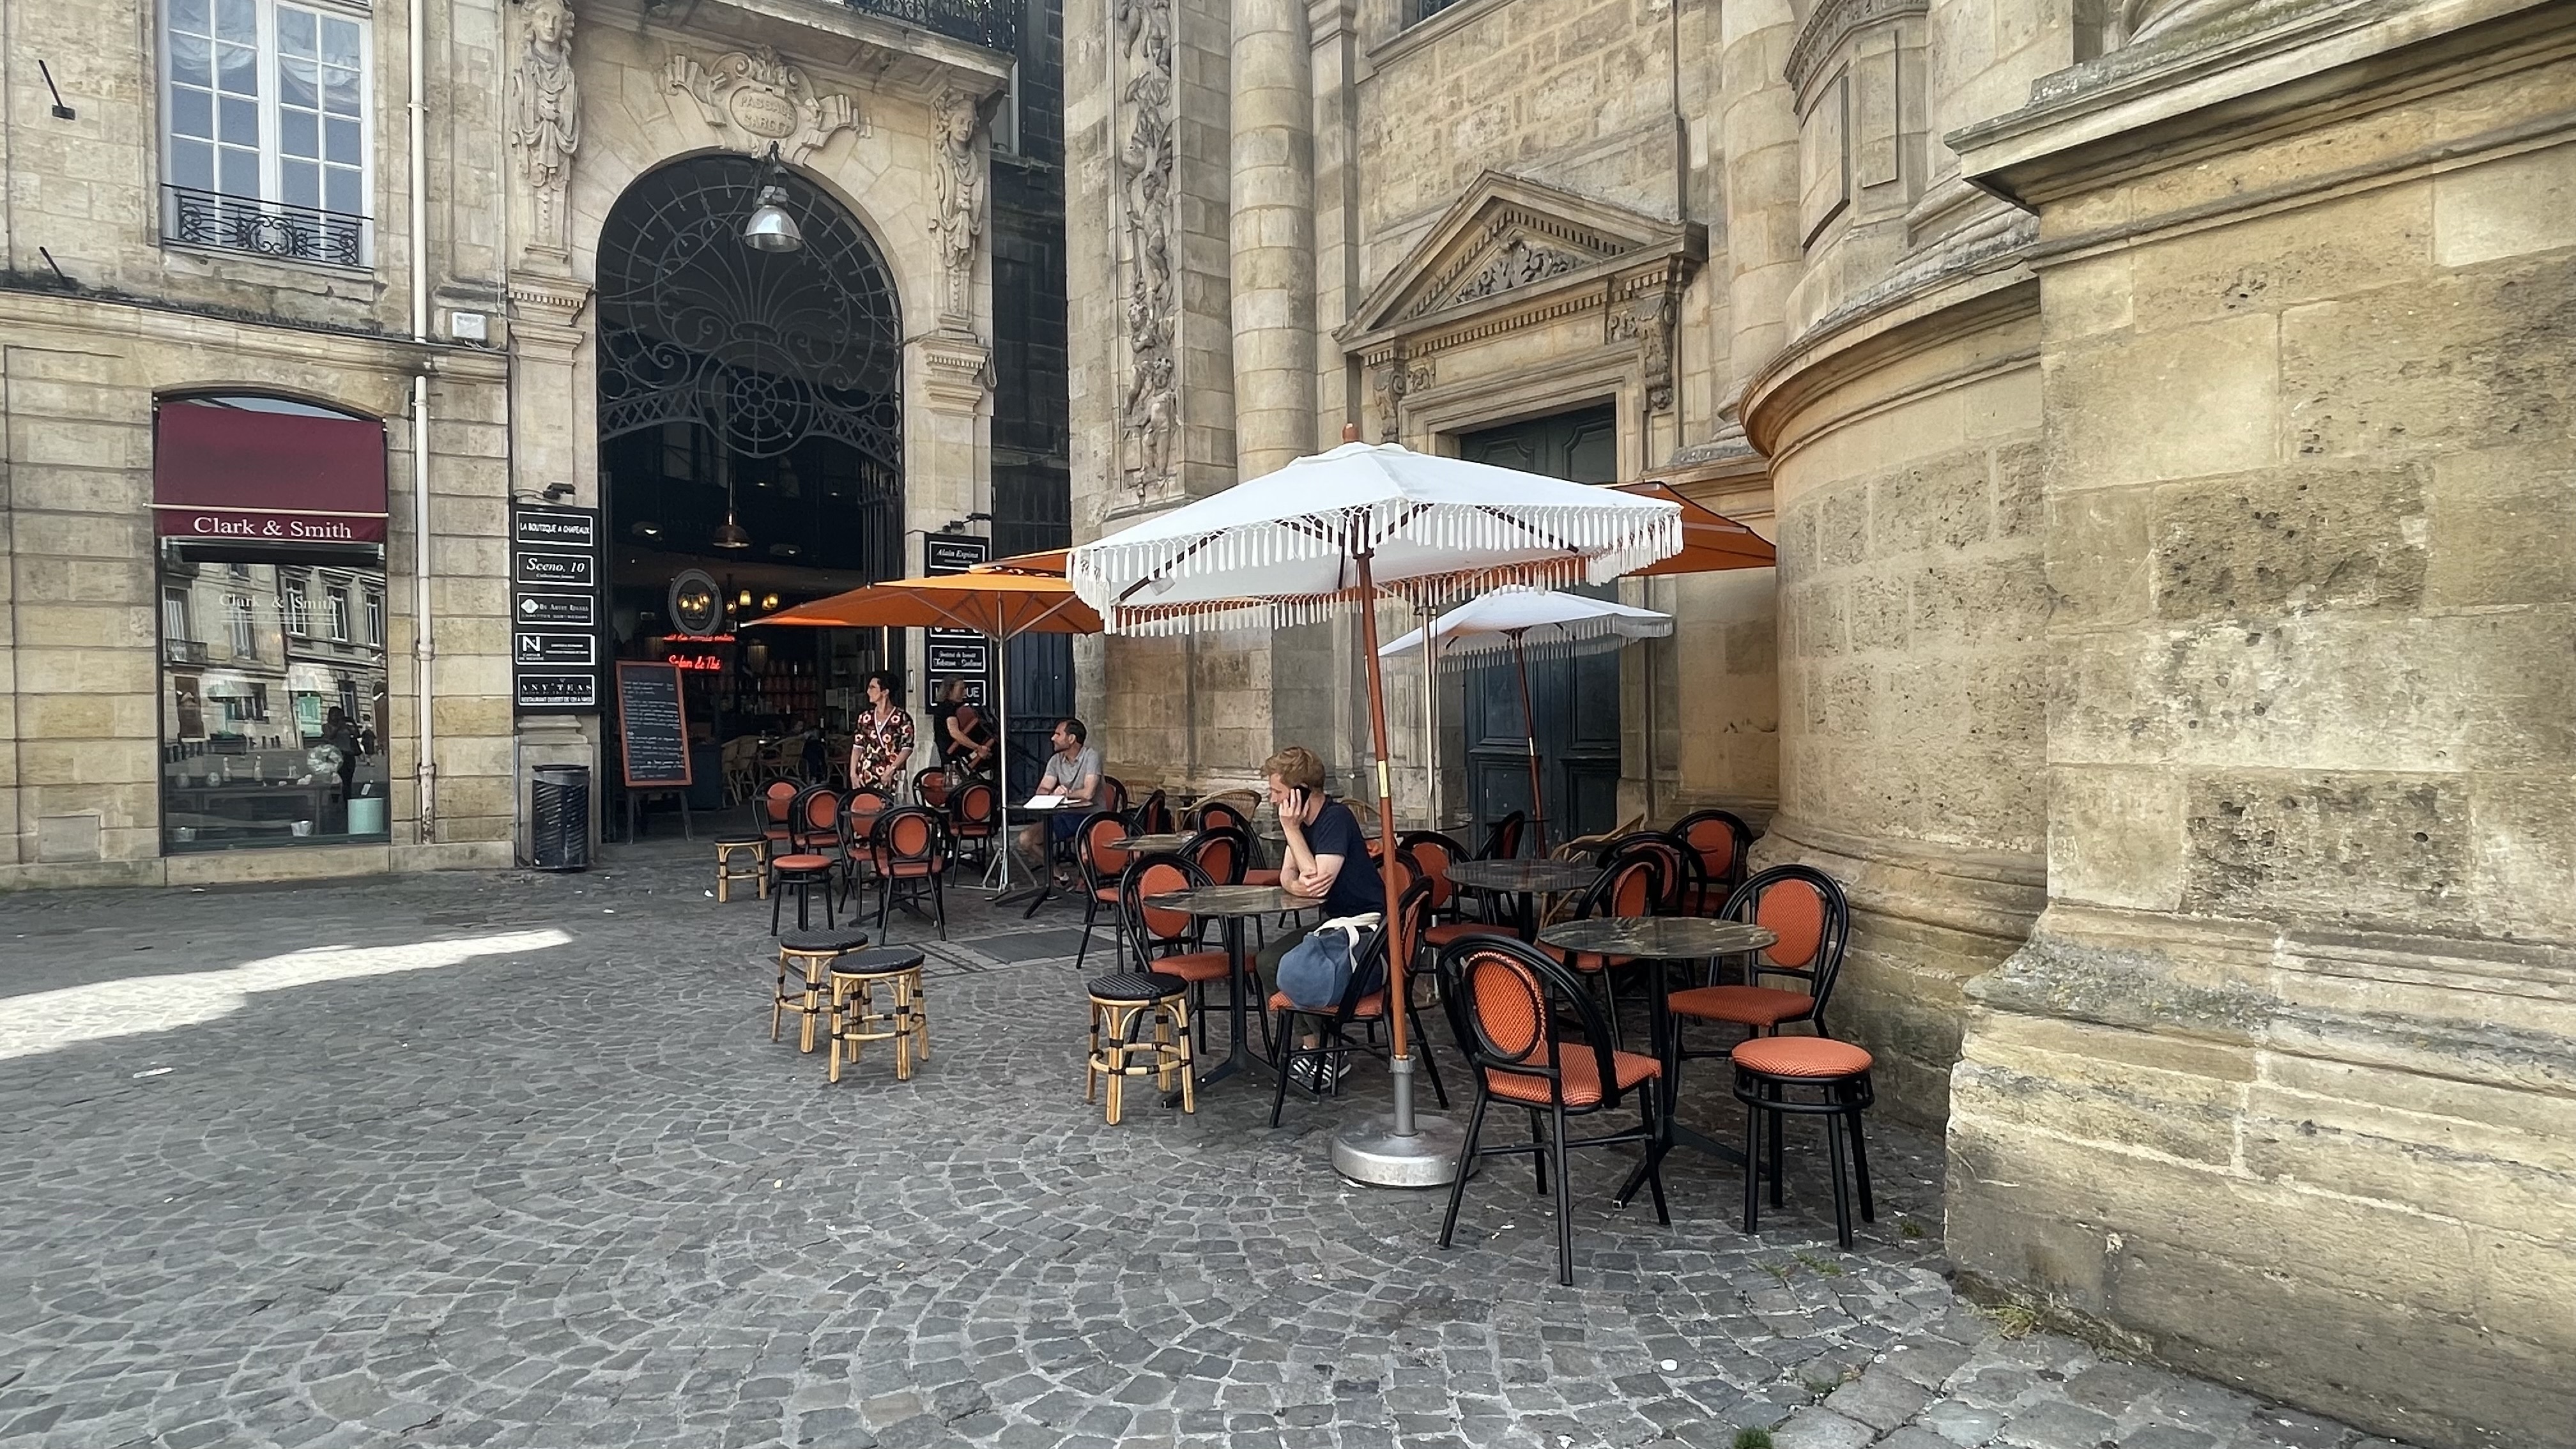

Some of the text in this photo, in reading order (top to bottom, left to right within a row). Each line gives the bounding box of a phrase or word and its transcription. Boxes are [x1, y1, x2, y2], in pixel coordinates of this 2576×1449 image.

[740, 96, 793, 121] PASSAGE
[194, 517, 352, 539] Clark & Smith
[519, 523, 528, 532] LA
[571, 562, 585, 572] 10
[218, 593, 261, 608] Clark
[272, 595, 284, 608] &
[523, 635, 540, 652] N
